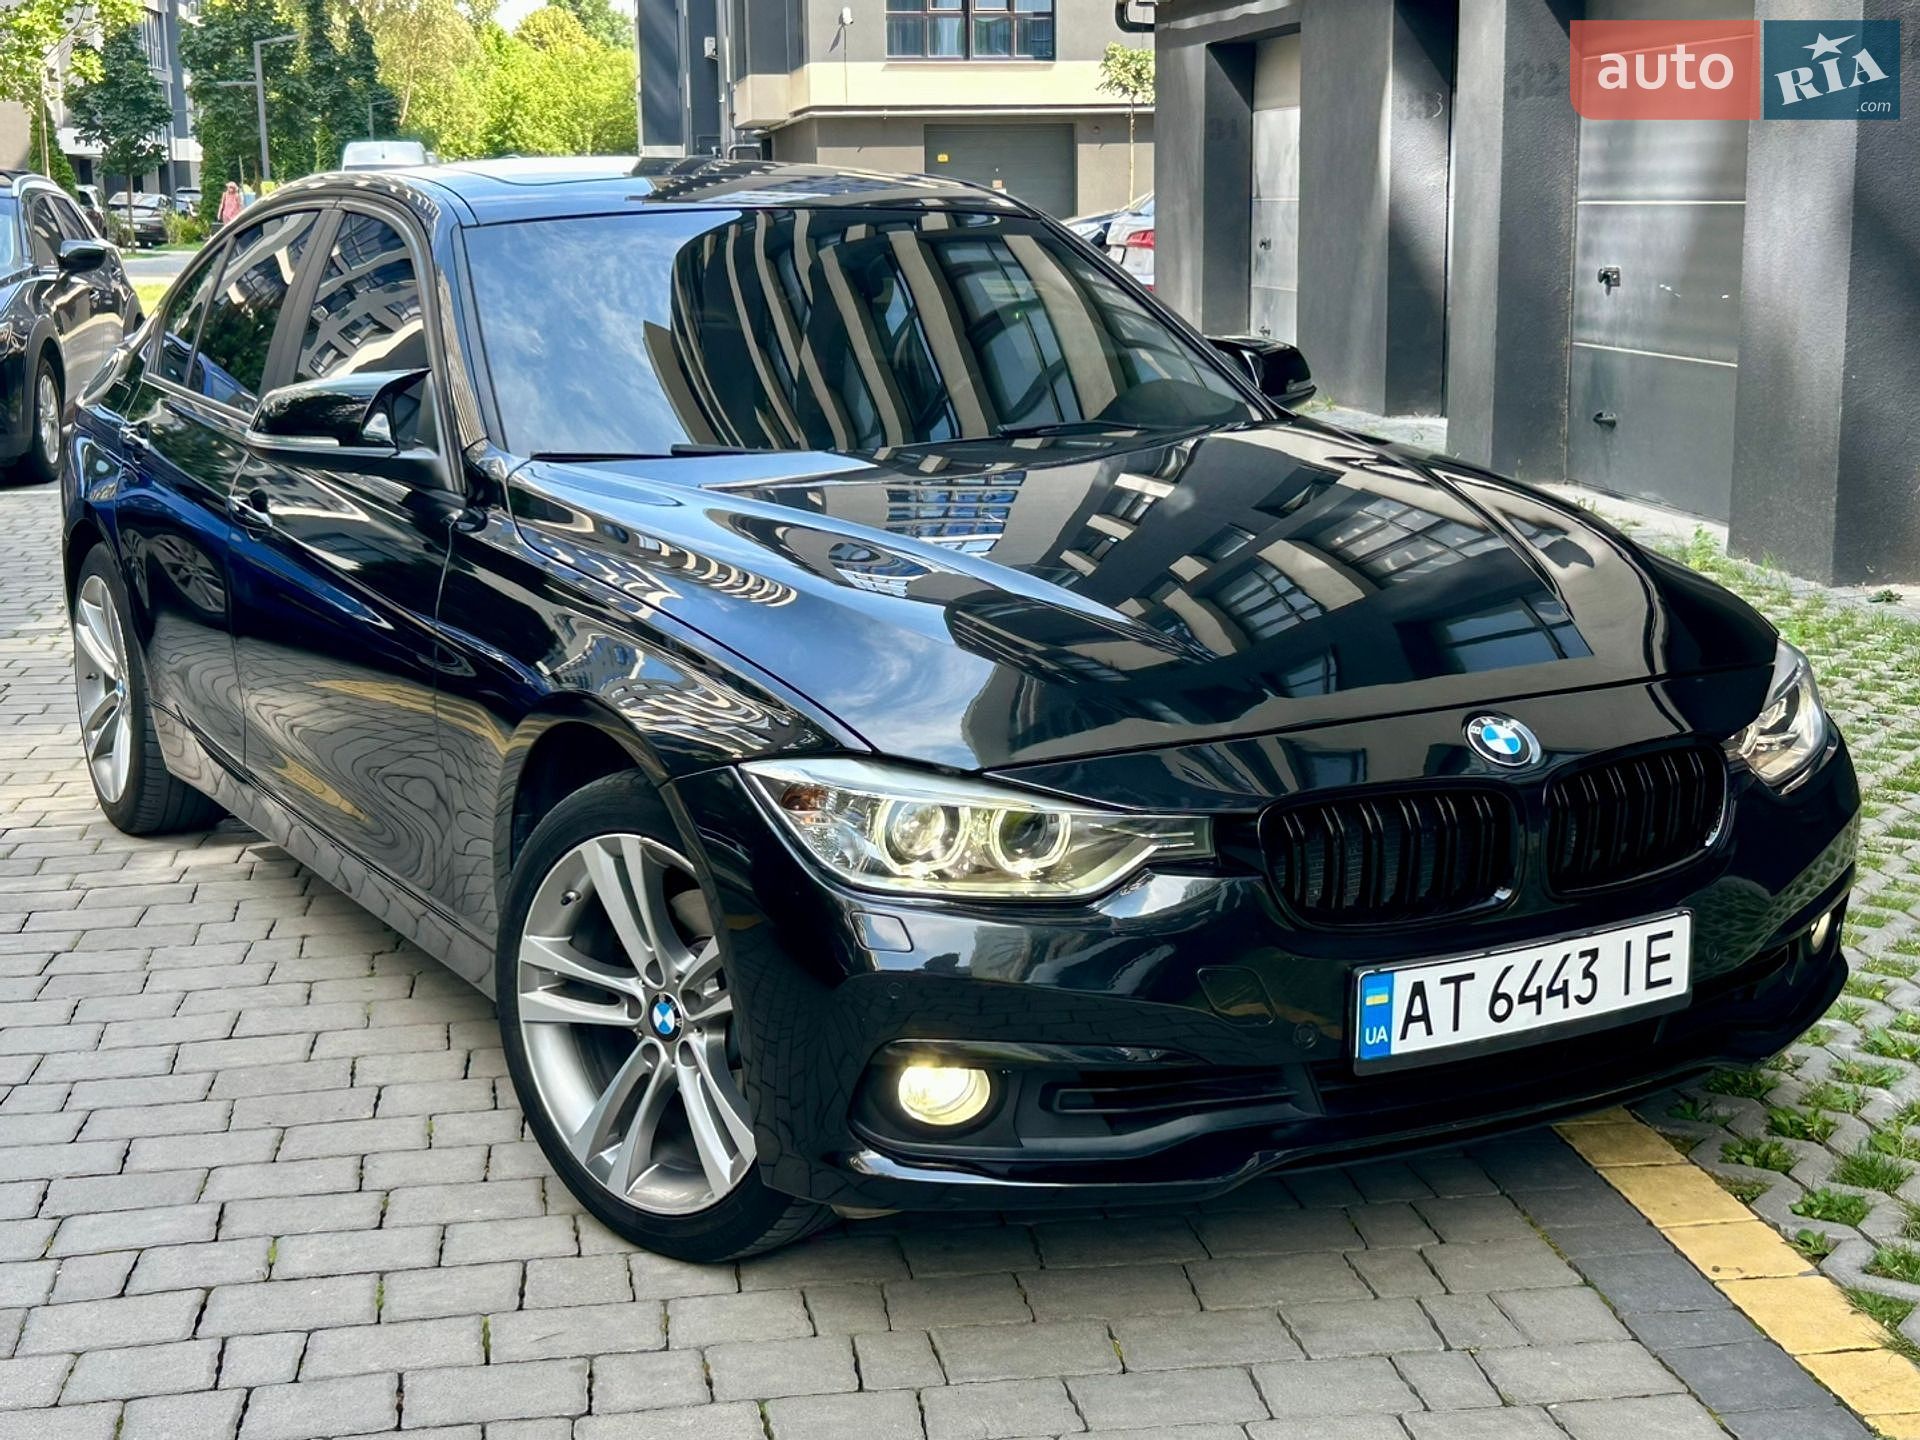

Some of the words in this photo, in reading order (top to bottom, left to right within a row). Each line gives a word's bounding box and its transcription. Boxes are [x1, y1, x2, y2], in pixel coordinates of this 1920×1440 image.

[1399, 972, 1476, 1041] AT
[1488, 947, 1600, 1024] 6443
[1623, 930, 1675, 996] IE
[1365, 1025, 1388, 1045] UA
